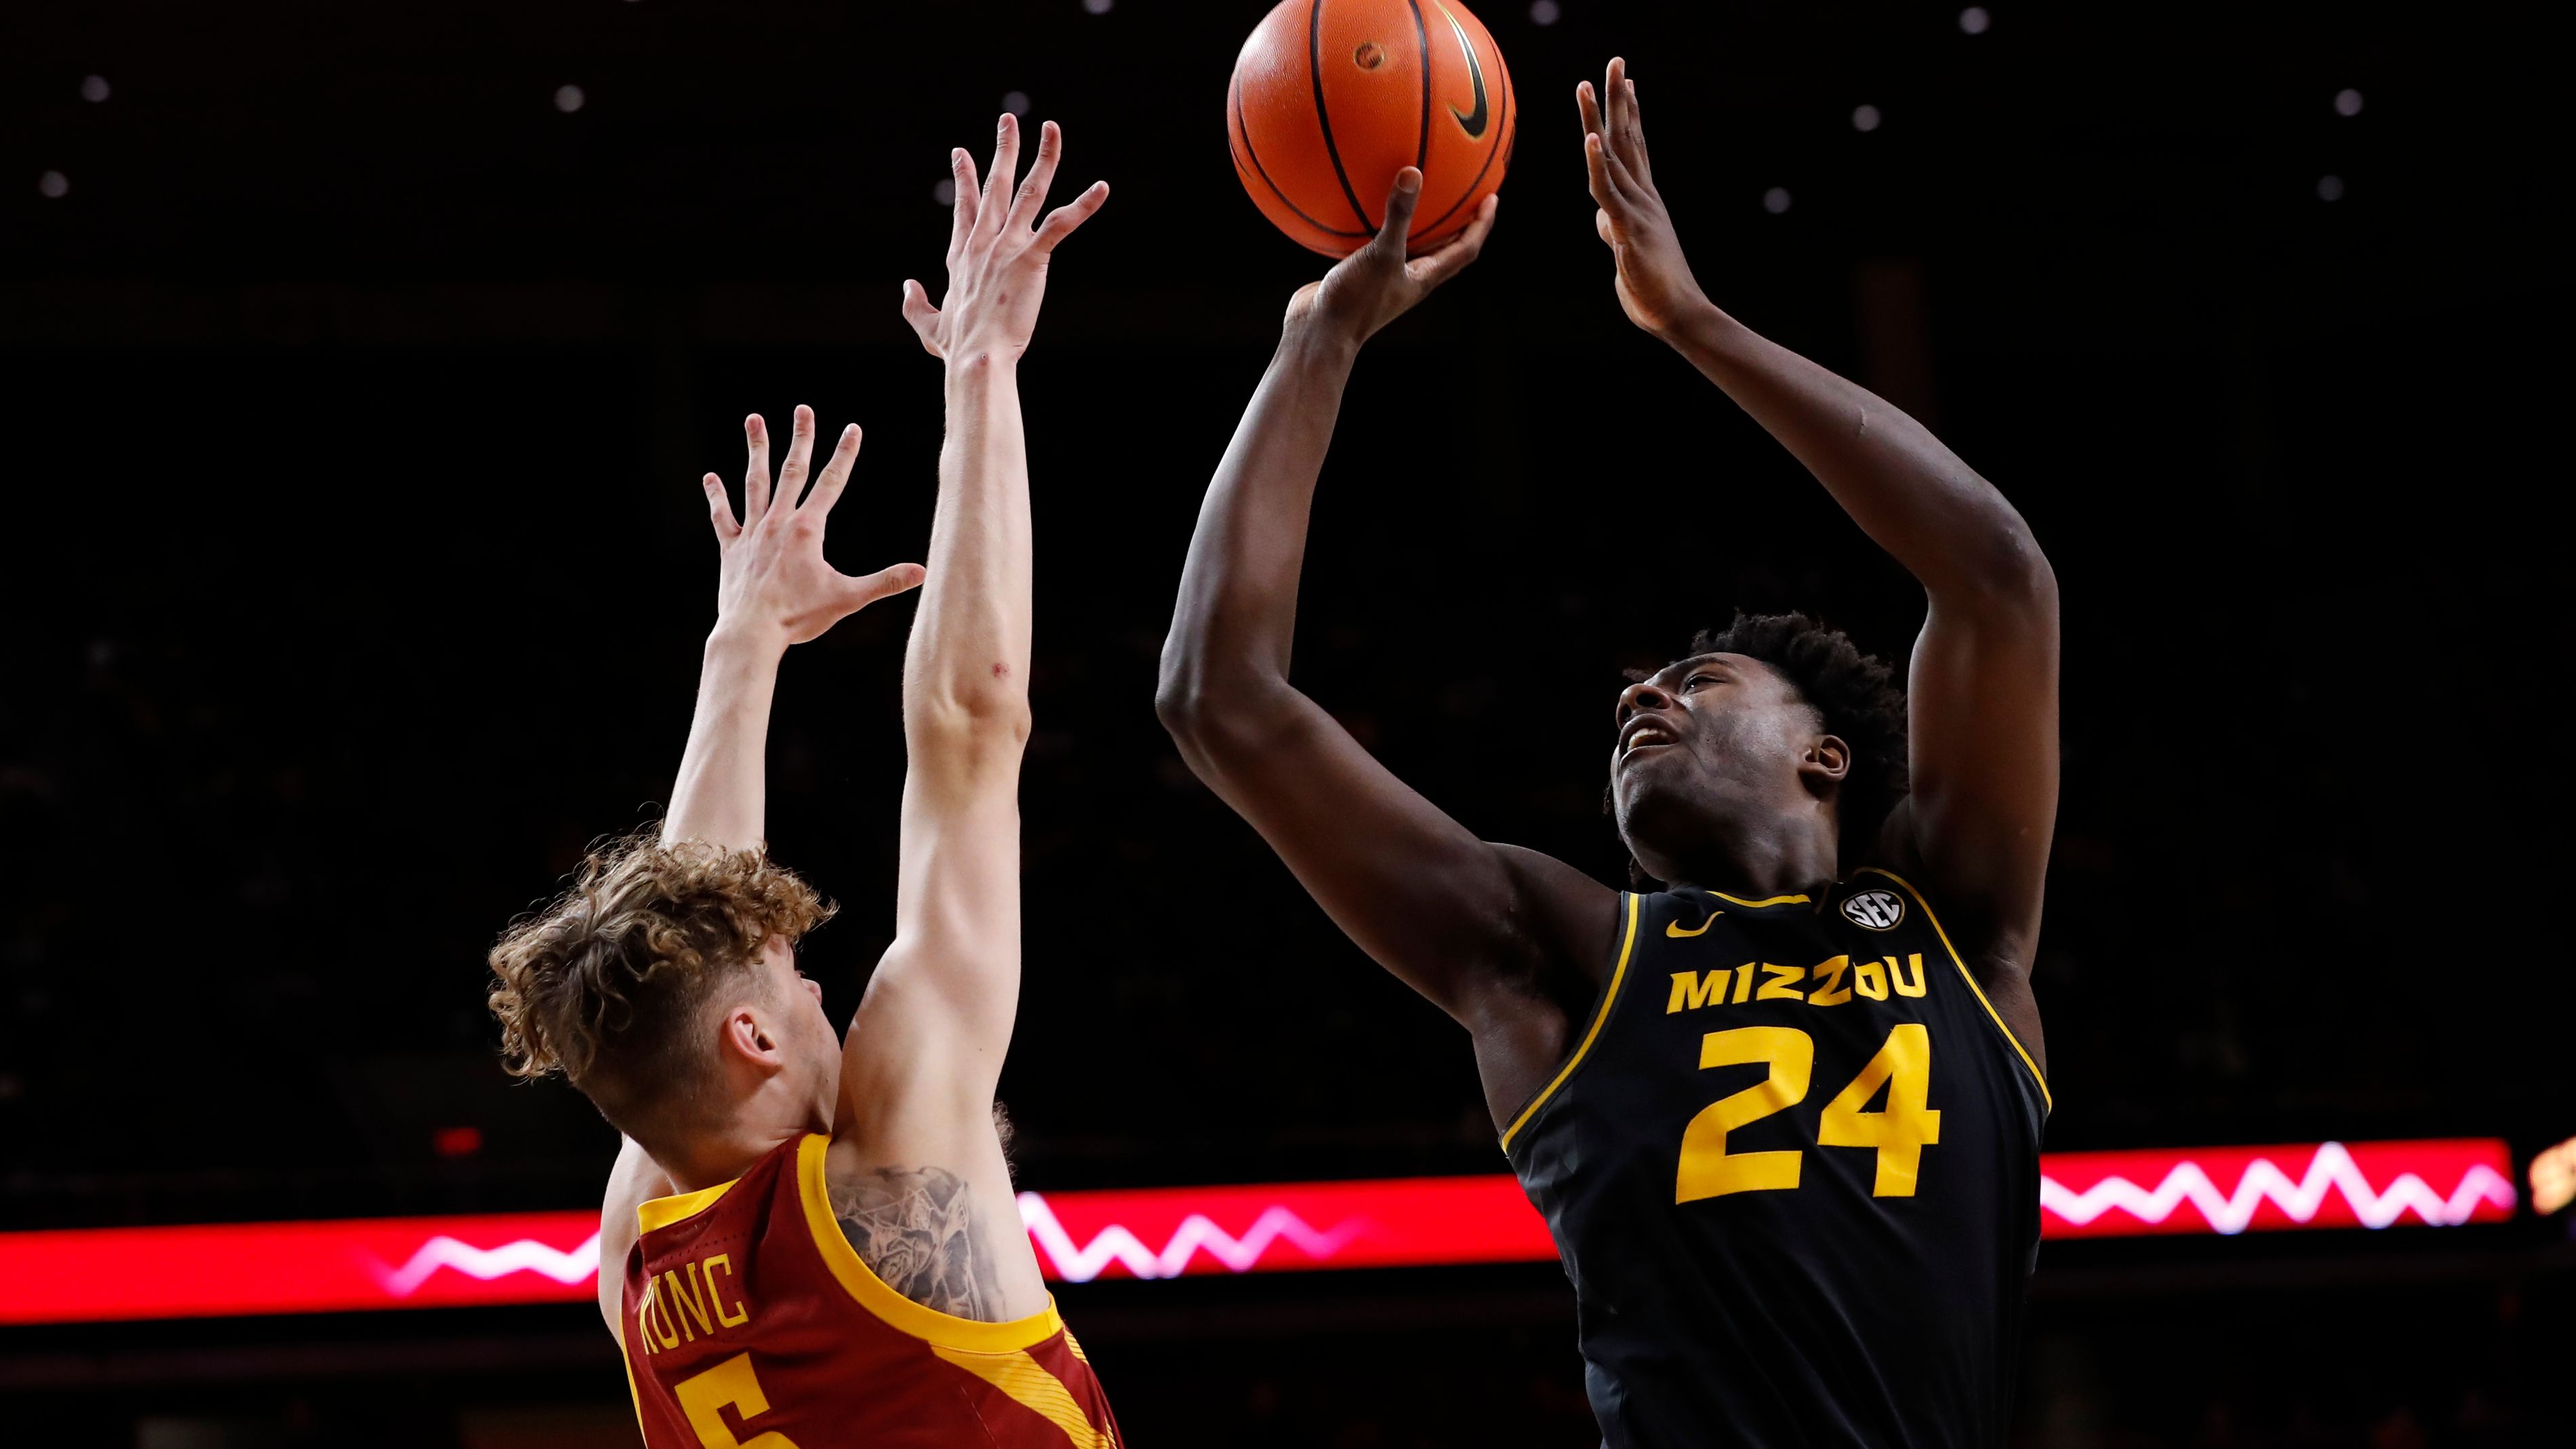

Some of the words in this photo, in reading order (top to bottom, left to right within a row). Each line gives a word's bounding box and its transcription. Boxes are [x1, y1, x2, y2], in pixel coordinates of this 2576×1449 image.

[1846, 893, 1899, 928] SEC
[1666, 953, 1927, 1015] MIZZOU
[1676, 1023, 1941, 1205] 24
